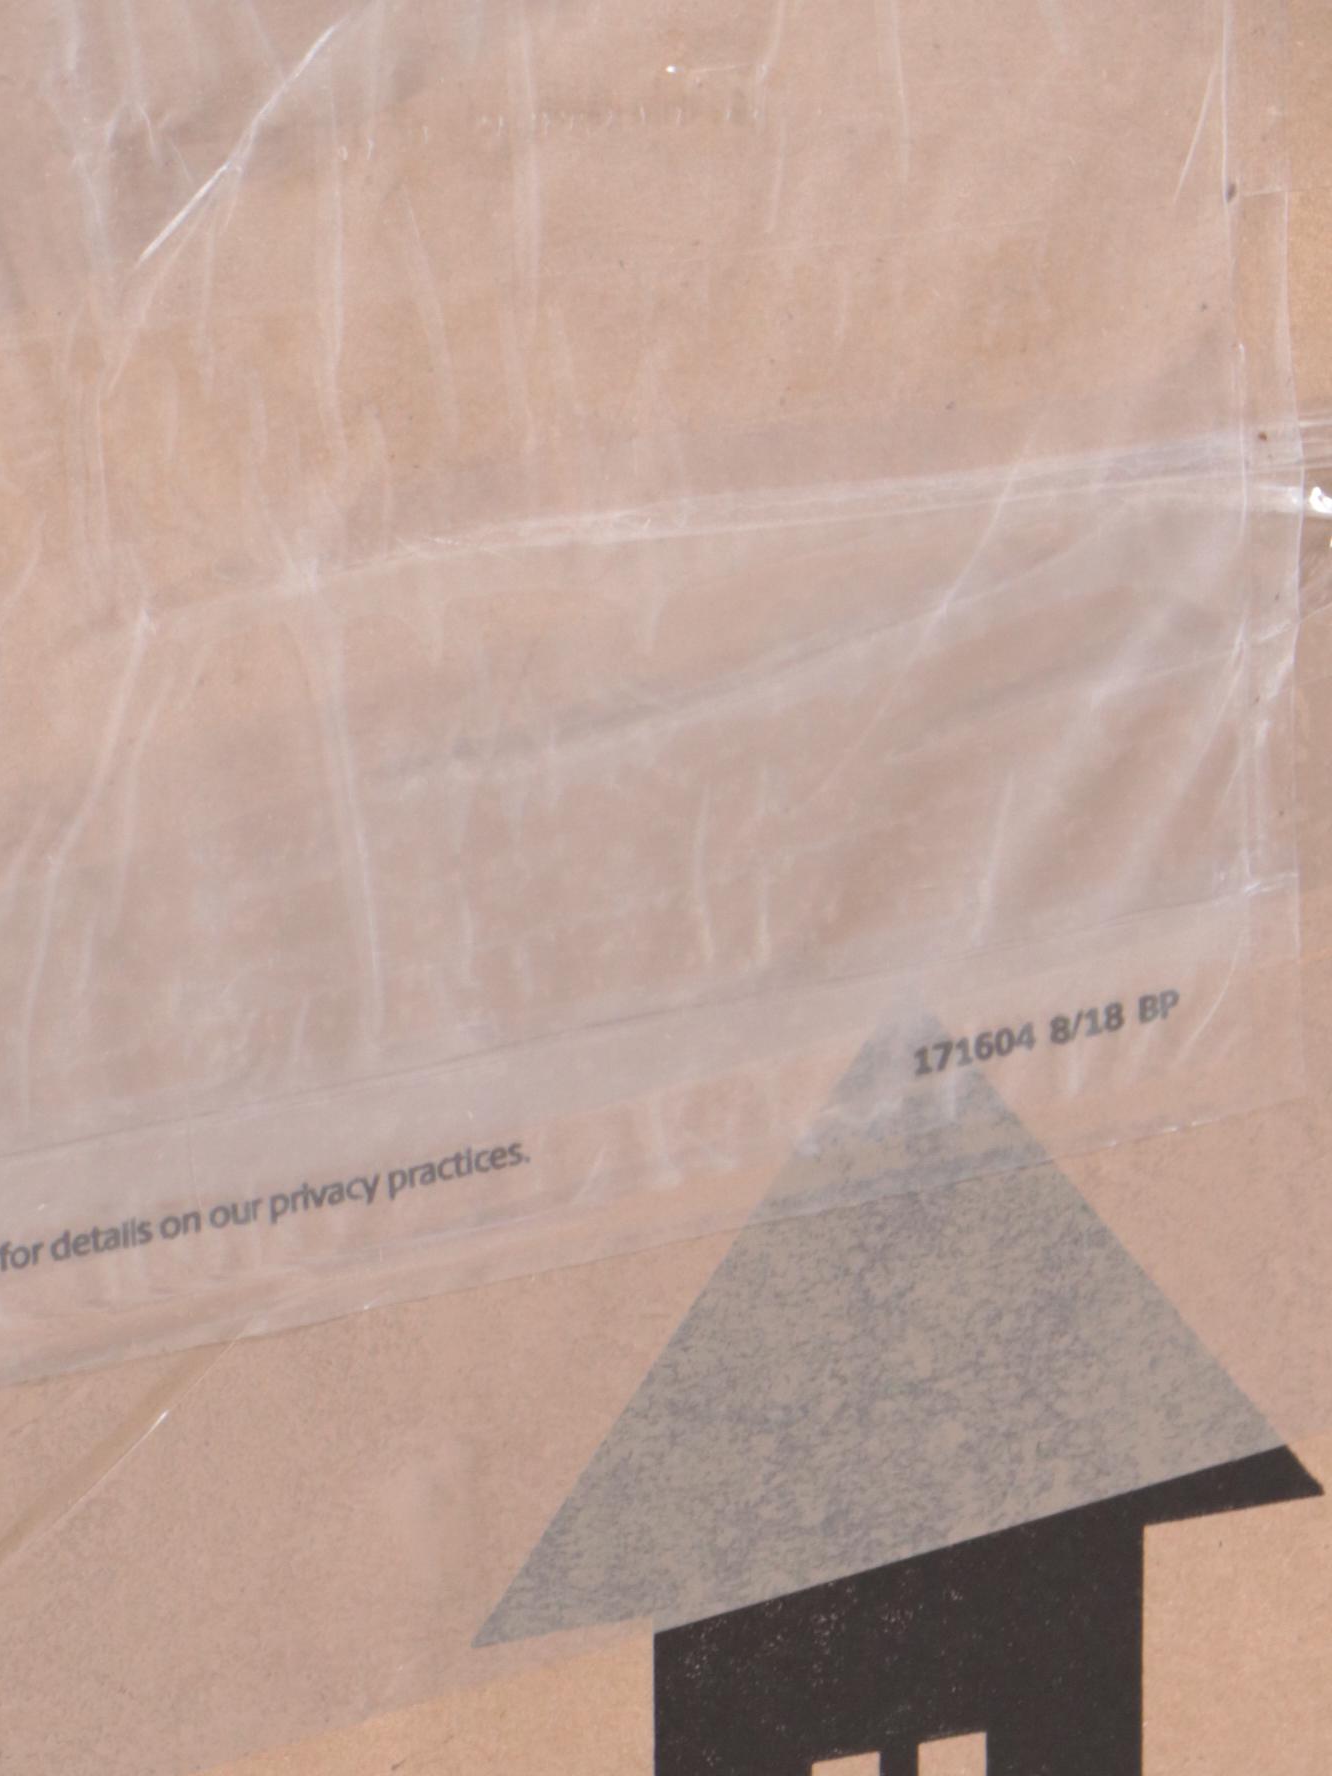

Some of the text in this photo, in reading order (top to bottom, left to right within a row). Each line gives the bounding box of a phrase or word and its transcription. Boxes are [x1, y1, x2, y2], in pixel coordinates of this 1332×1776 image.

[914, 990, 1180, 1077] 171604 8/18 BP
[50, 1218, 153, 1262] details
[160, 1210, 201, 1241] on
[208, 1198, 264, 1230] our
[269, 1173, 381, 1224] privacy
[388, 1138, 531, 1201] practices.
